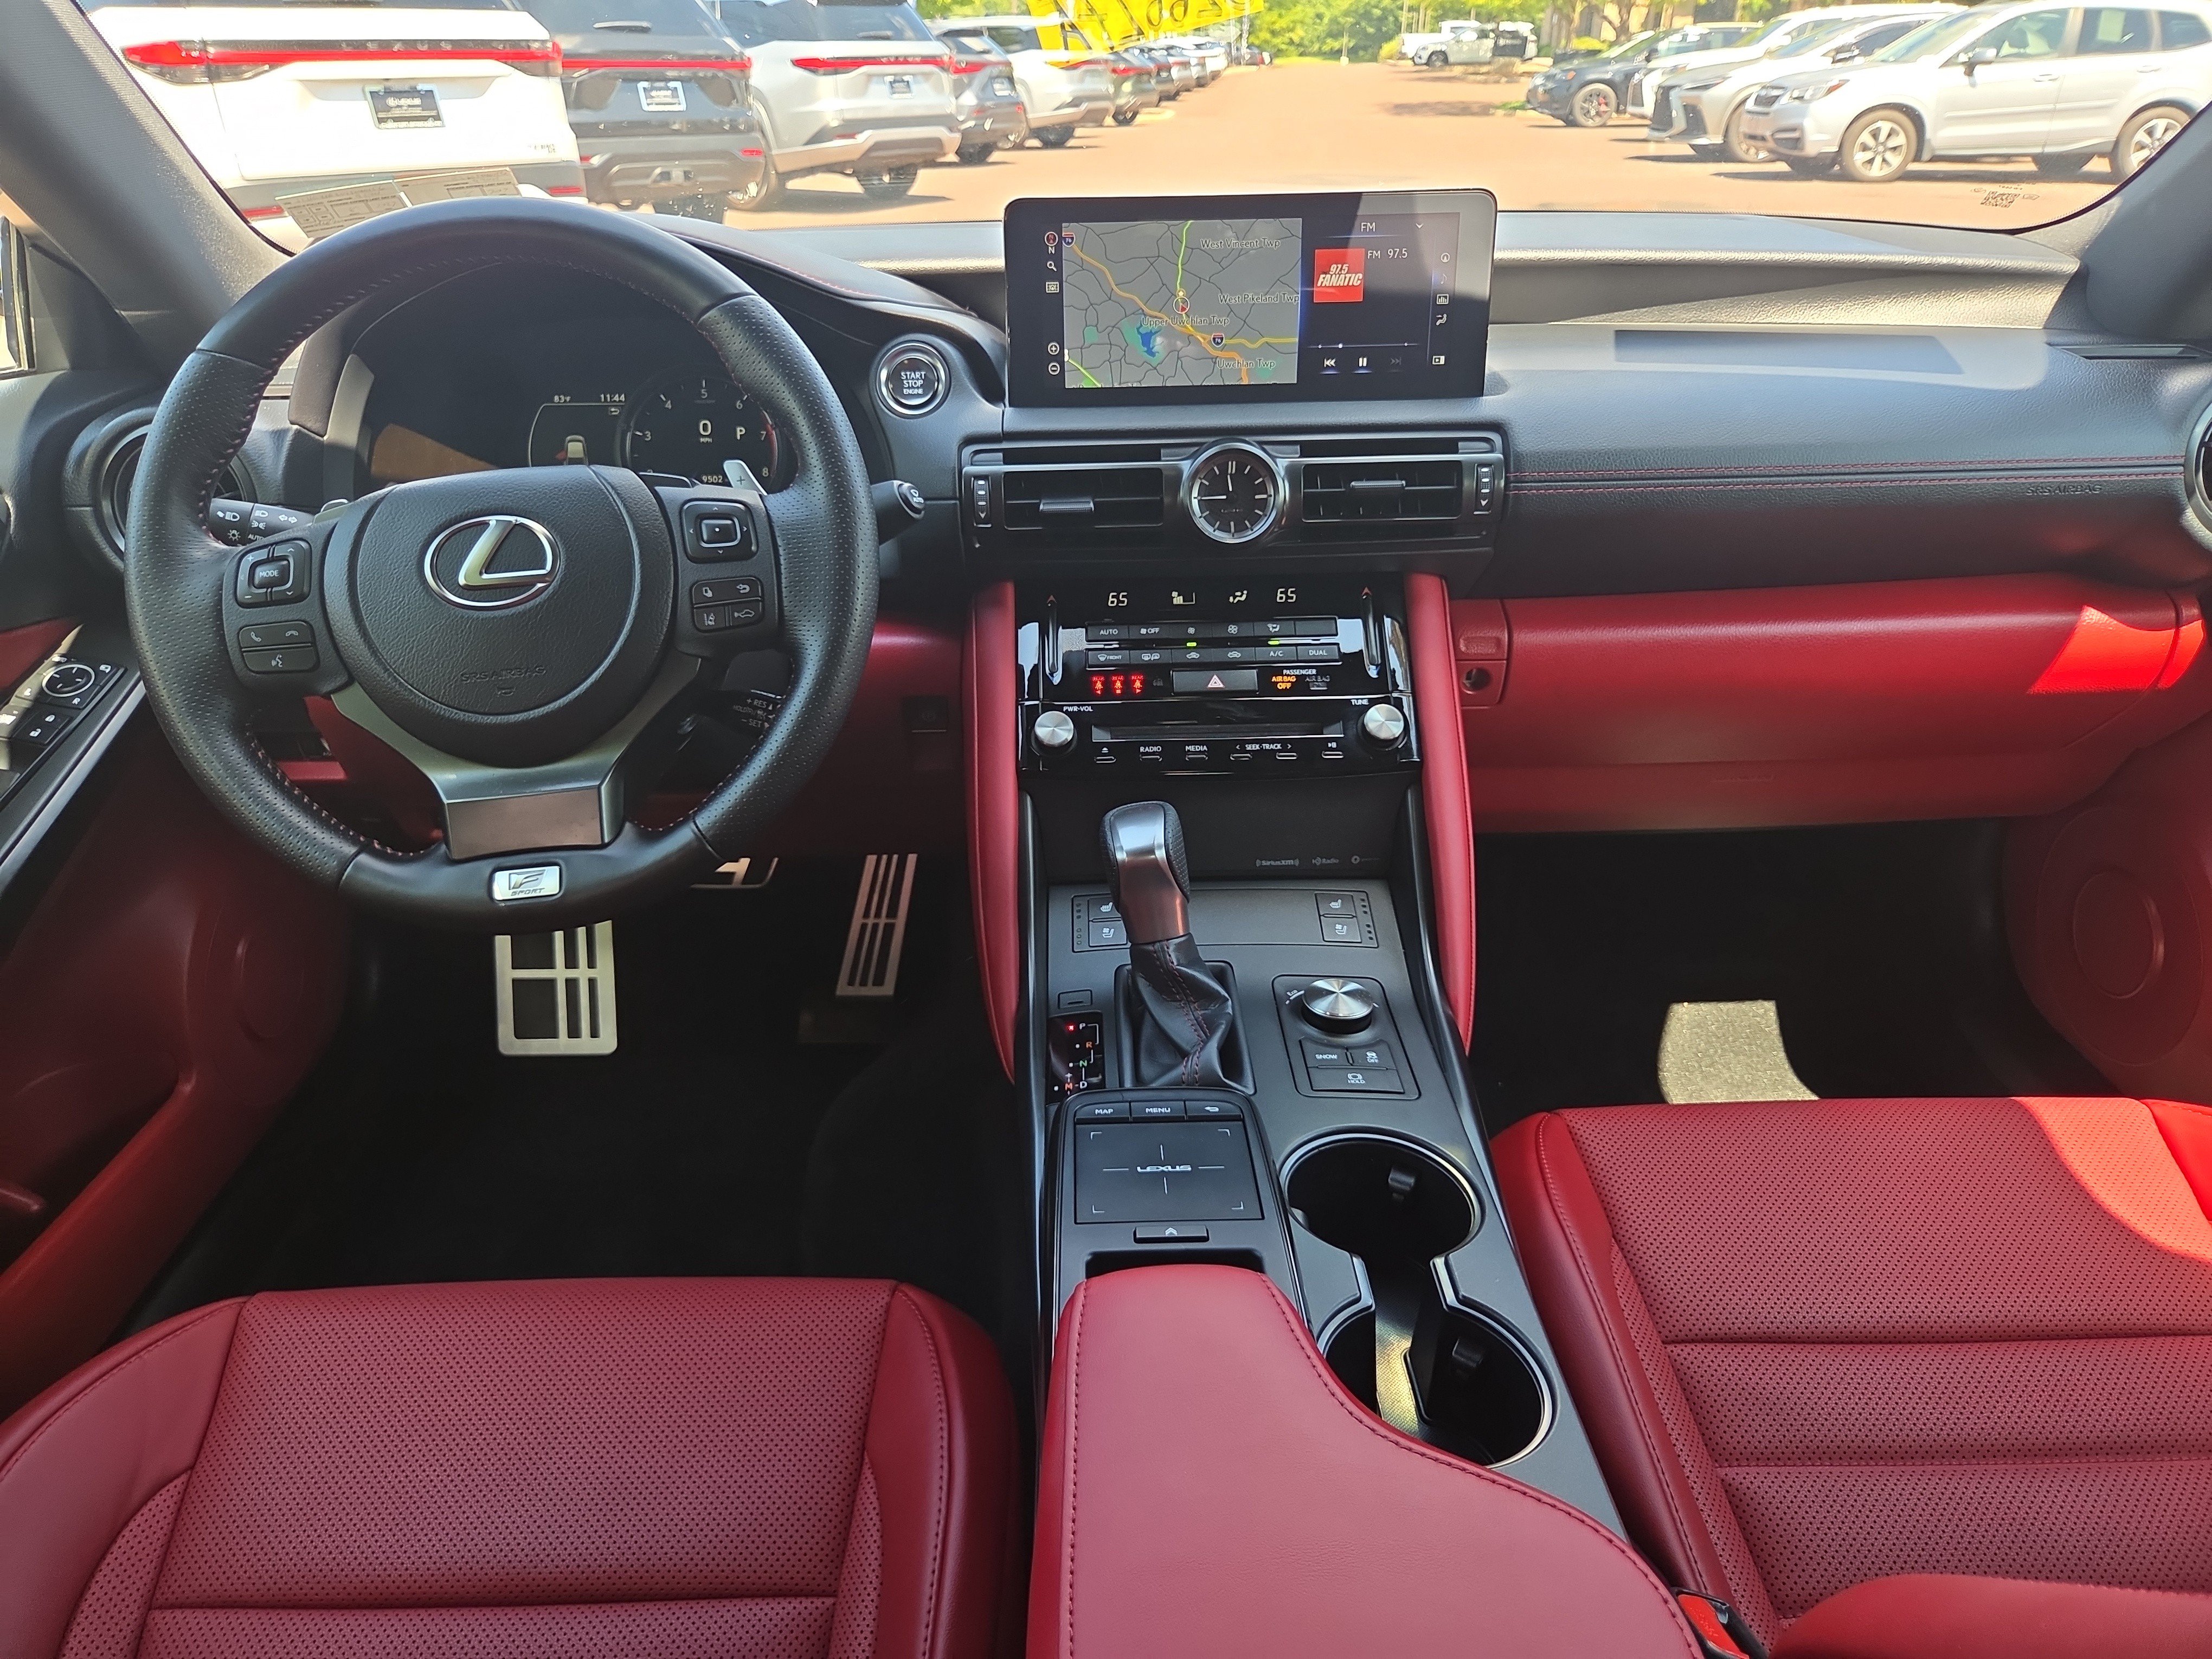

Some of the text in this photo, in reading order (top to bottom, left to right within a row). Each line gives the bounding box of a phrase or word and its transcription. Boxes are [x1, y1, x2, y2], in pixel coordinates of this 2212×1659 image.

[1361, 222, 1375, 232] FM
[1200, 237, 1281, 250] West Vincent Twp
[1048, 246, 1055, 254] N
[1367, 248, 1408, 259] FM 97.5
[1329, 264, 1349, 275] 97.5
[1317, 273, 1362, 287] FANATIC
[1219, 293, 1300, 305] West Pikeland Twp
[1141, 315, 1229, 328] Upper Uwchlan Twp
[1217, 358, 1275, 370] Uwchlan Twp
[901, 371, 926, 380] START
[600, 393, 625, 402] 11:44
[701, 389, 708, 398] 5
[665, 400, 672, 409] 4
[736, 401, 743, 409] 6
[699, 420, 711, 436] 0
[645, 431, 651, 441] 3
[736, 427, 745, 440] P
[761, 432, 767, 441] 7
[762, 467, 769, 477] 8
[702, 475, 723, 483] 9502
[1108, 592, 1128, 607] 65
[1276, 588, 1297, 603] 65
[511, 888, 545, 897] SPORT
[1080, 1081, 1087, 1089] D
